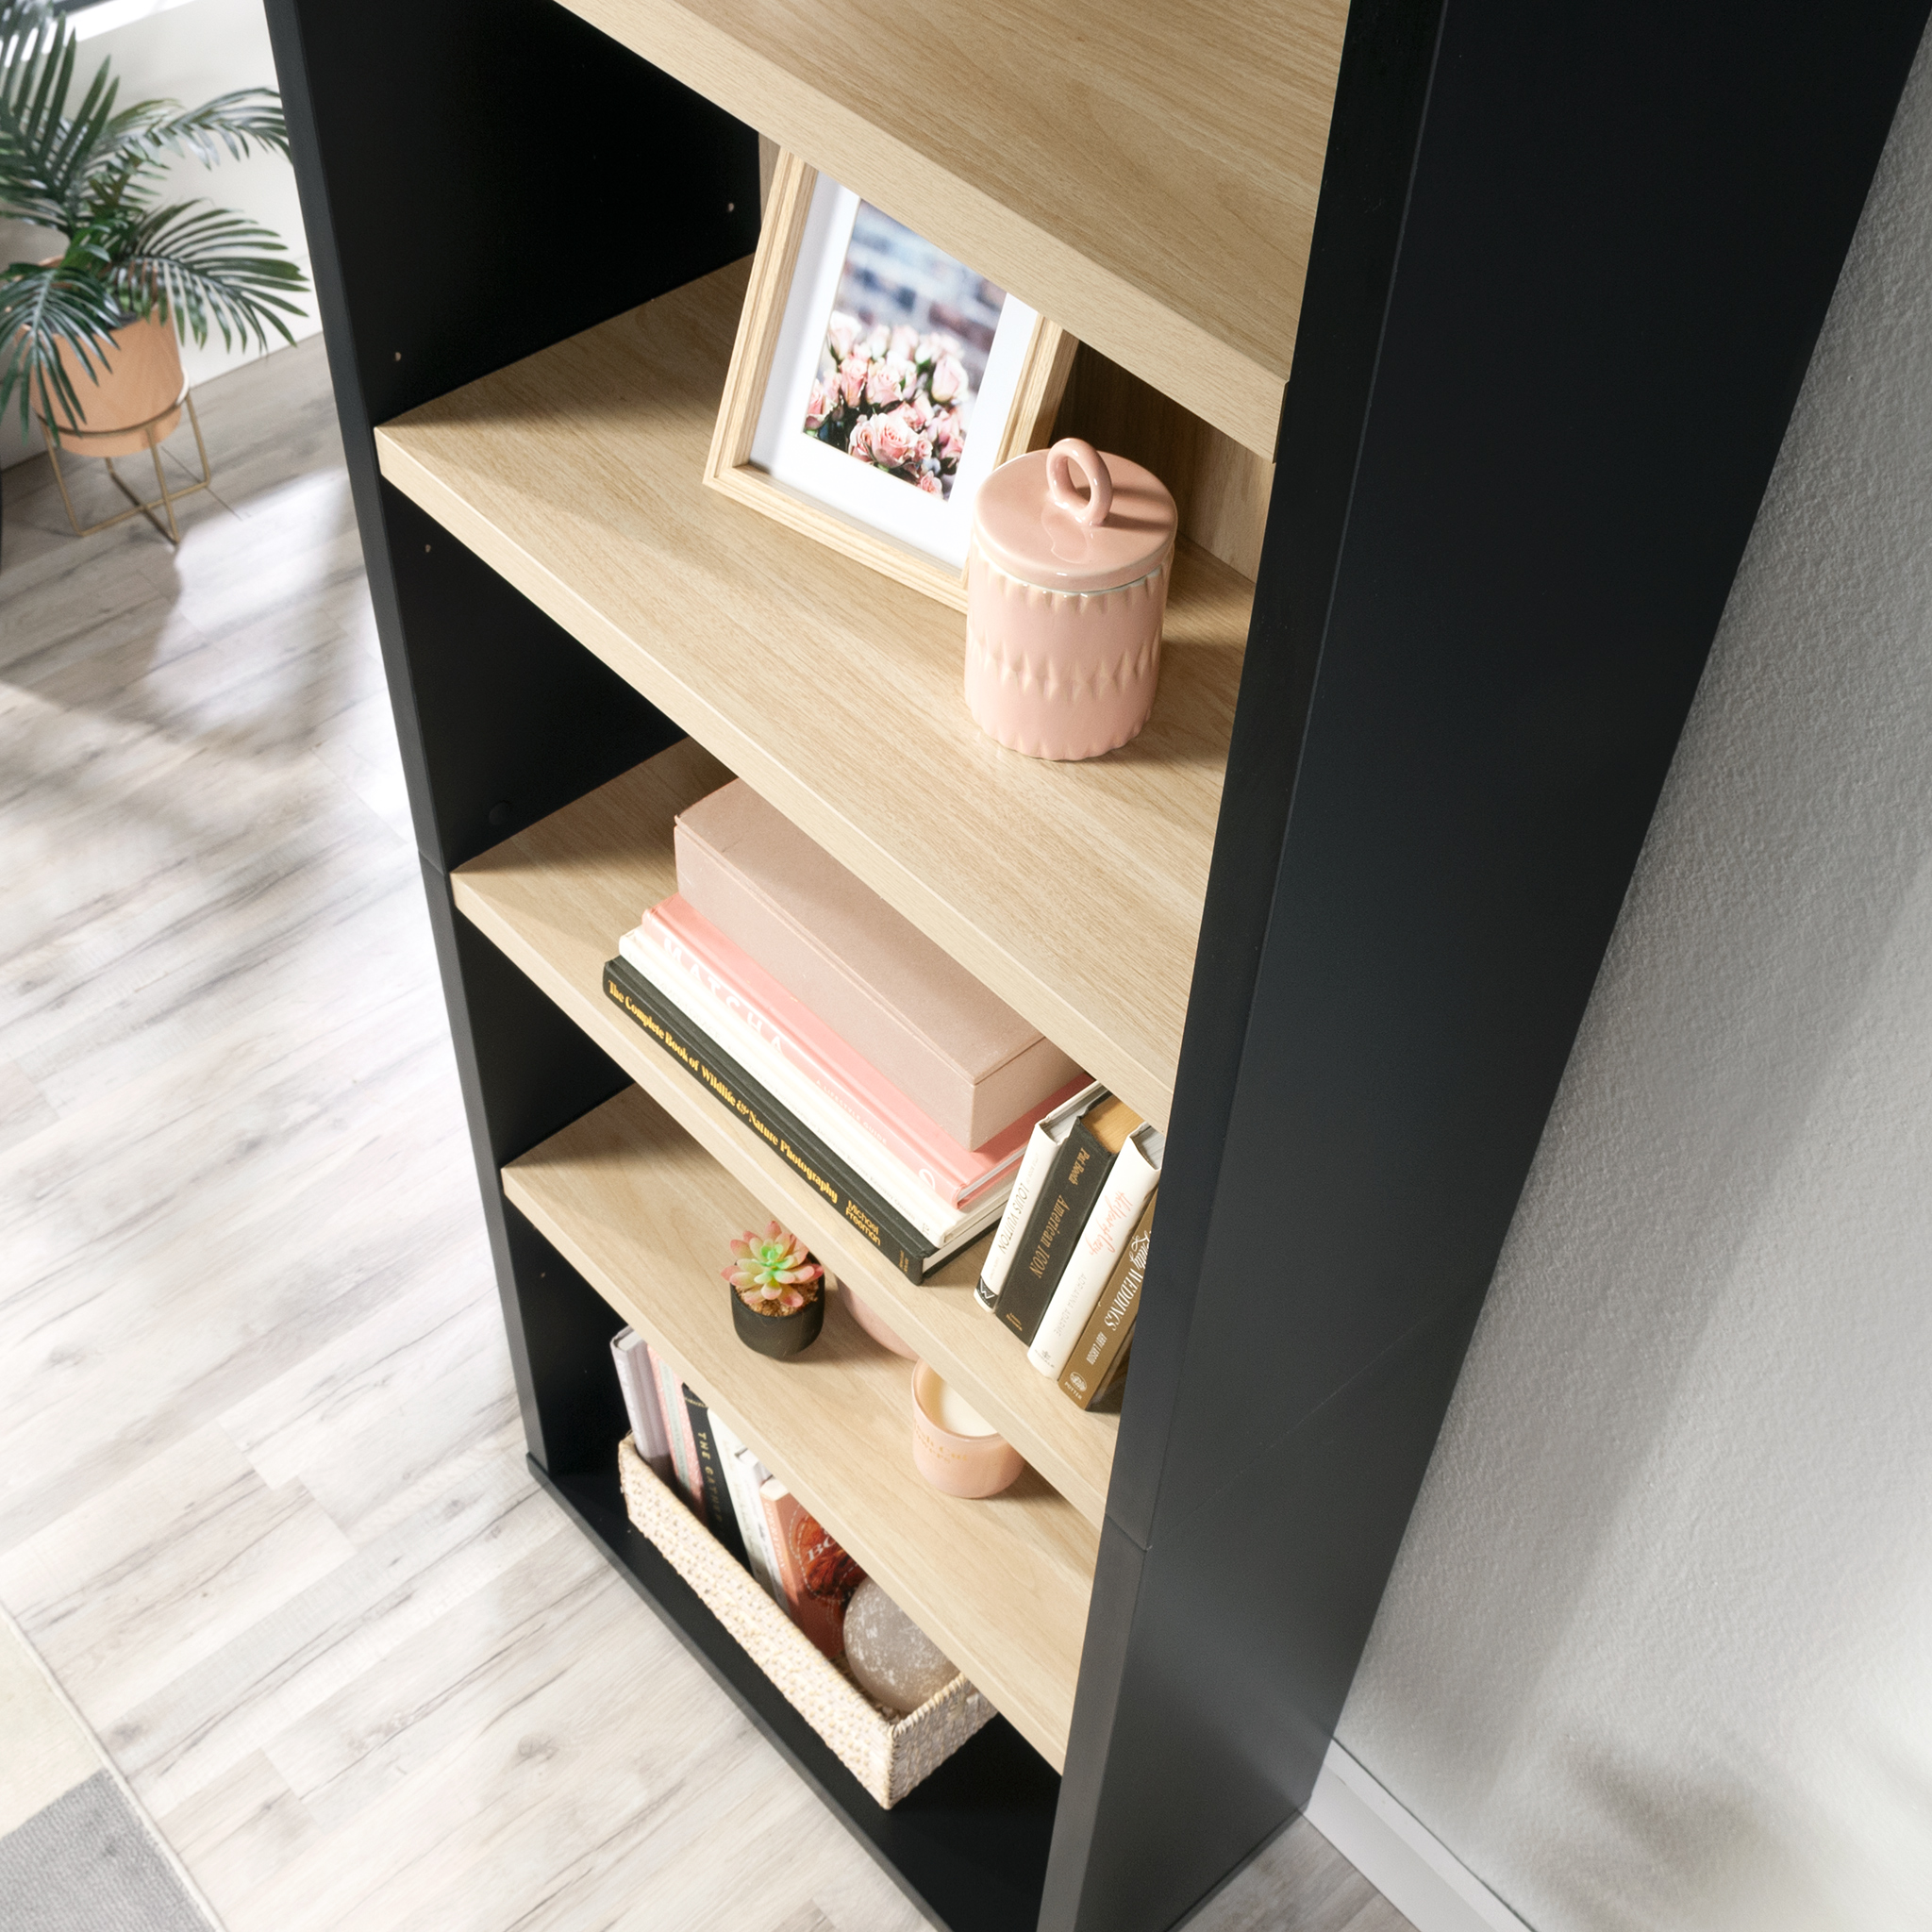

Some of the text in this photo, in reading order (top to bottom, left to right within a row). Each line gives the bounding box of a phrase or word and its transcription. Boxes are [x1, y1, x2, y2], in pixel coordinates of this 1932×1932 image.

[663, 937, 782, 1057] MATCHA
[608, 979, 625, 1003] The
[625, 995, 664, 1040] Complete
[664, 1031, 689, 1063] Book
[689, 1057, 700, 1072] of
[701, 1064, 736, 1107] Wildlife
[748, 1109, 779, 1145] Nature
[780, 1139, 838, 1204] Photography
[863, 1122, 887, 1143] GUIDE
[848, 1199, 879, 1236] Michael
[1012, 1182, 1030, 1215] LOUIS
[845, 1207, 881, 1246] Freeman
[1028, 1194, 1071, 1279] American ICON
[1104, 1267, 1143, 1331] WEDDINGS
[1064, 1381, 1083, 1401] POTTER
[698, 1432, 711, 1460] THE
